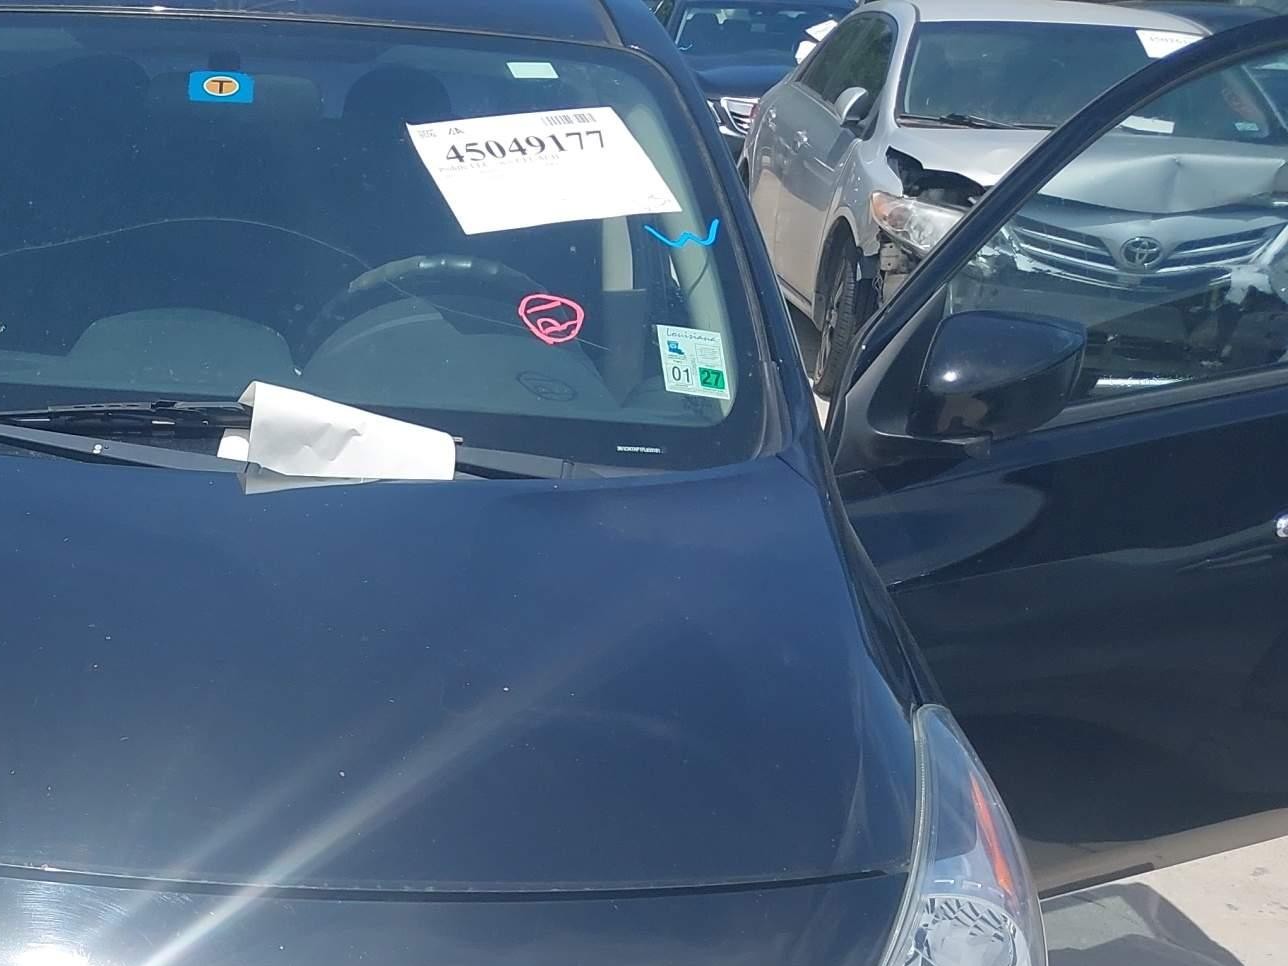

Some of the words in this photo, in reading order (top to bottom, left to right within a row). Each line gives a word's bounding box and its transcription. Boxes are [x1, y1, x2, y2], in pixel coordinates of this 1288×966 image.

[446, 130, 604, 163] 45049177
[666, 327, 717, 342] Louisiana
[672, 366, 691, 384] 01
[701, 370, 721, 387] 27
